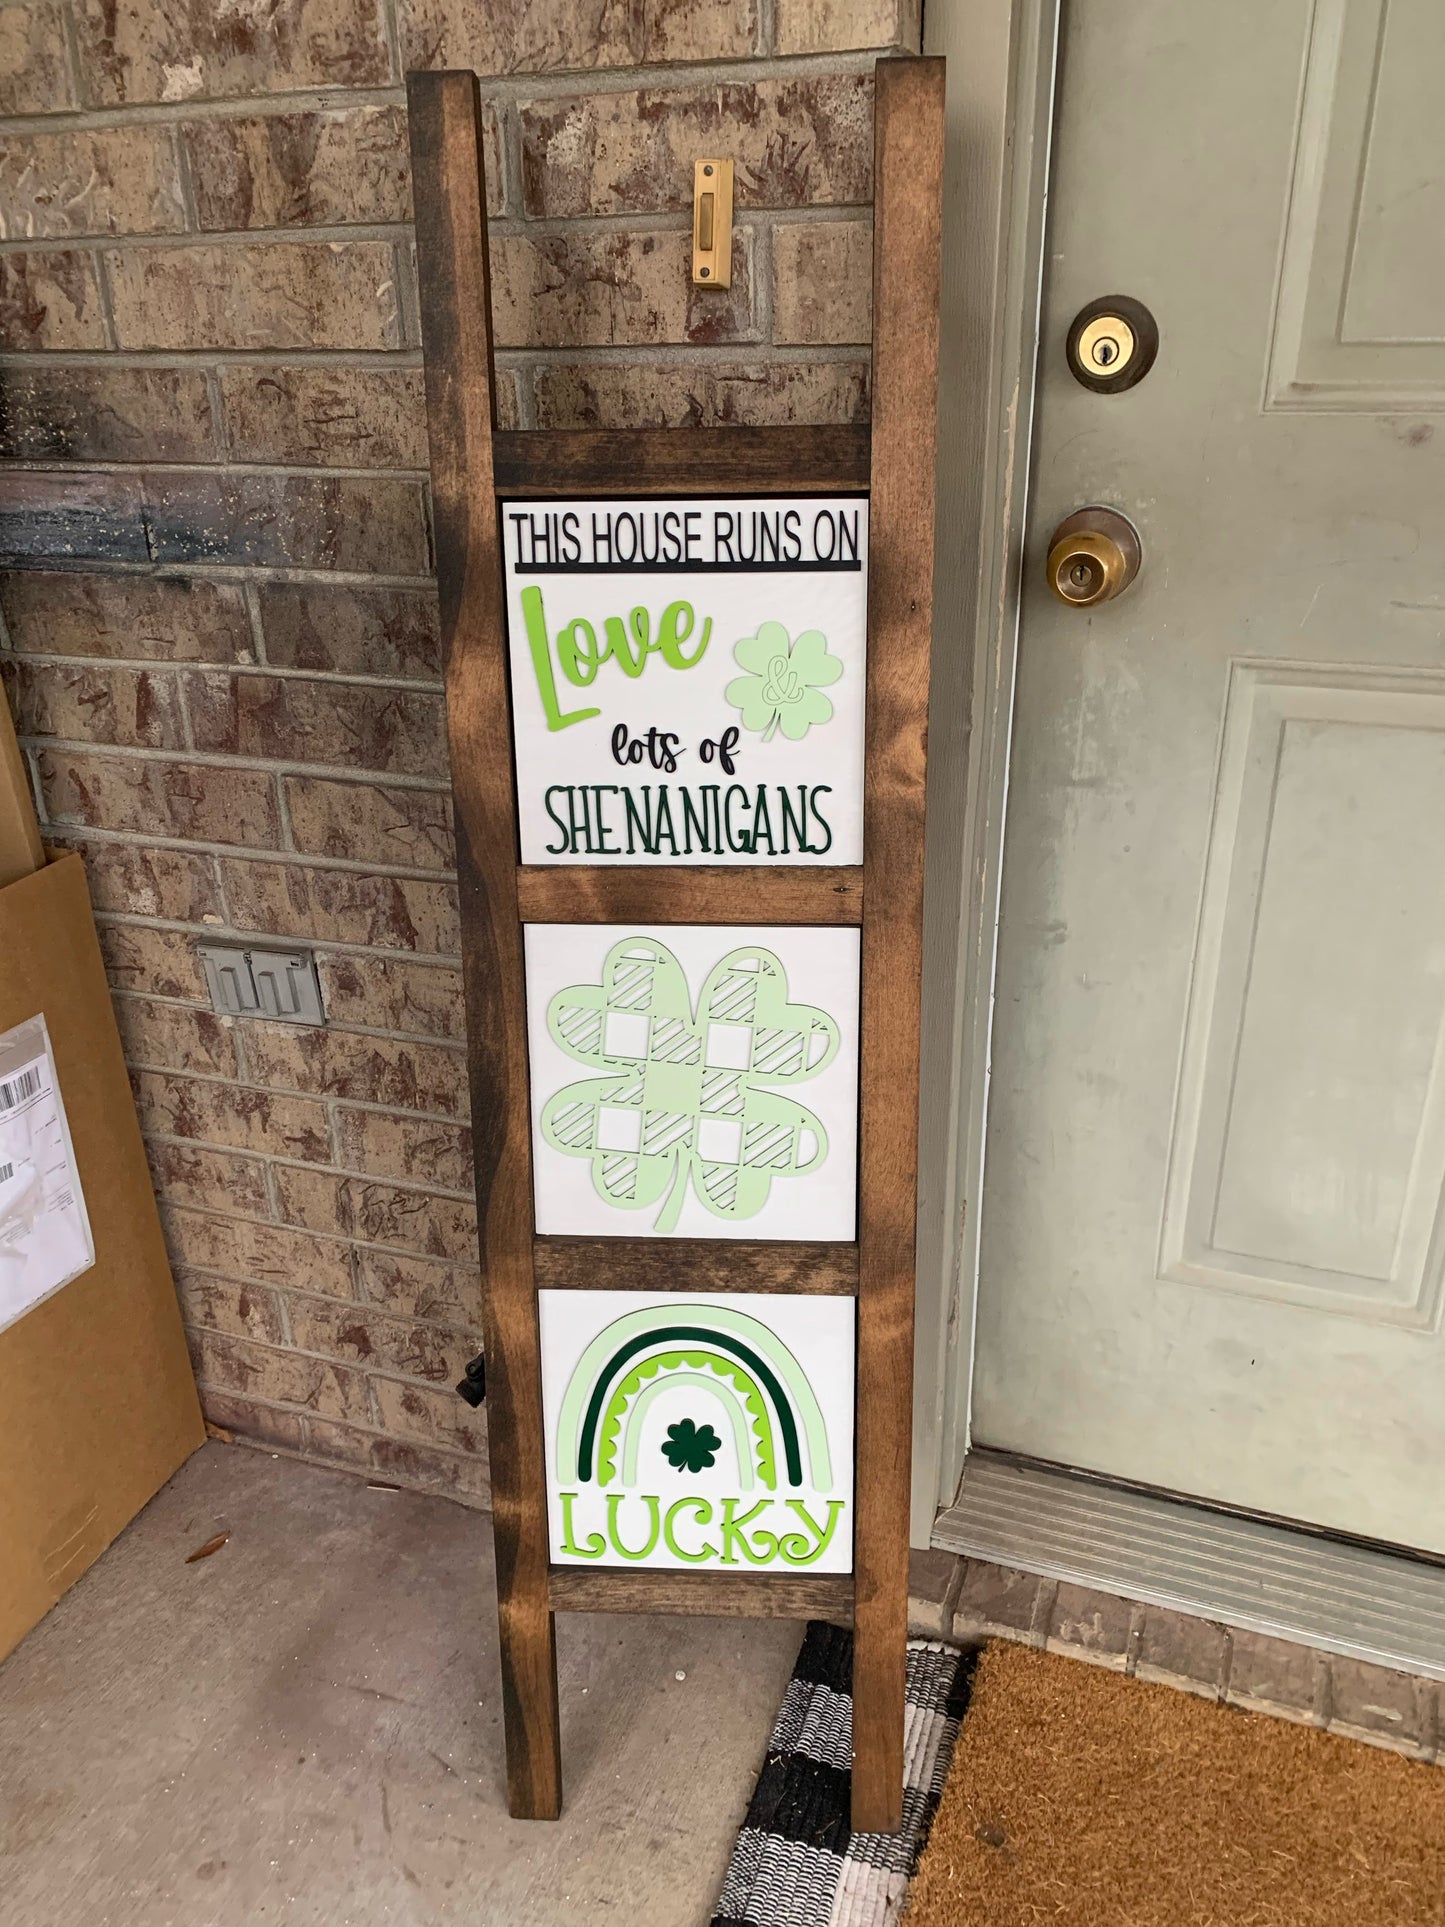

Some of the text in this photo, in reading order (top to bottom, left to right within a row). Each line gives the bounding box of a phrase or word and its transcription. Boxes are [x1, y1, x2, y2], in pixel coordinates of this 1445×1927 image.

[509, 509, 859, 564] THIS HOUSE RUNS ON
[520, 585, 804, 732] Love &
[611, 723, 740, 776] lots of
[545, 783, 833, 856] SHENANIGANS
[558, 1492, 845, 1566] LUCKY
